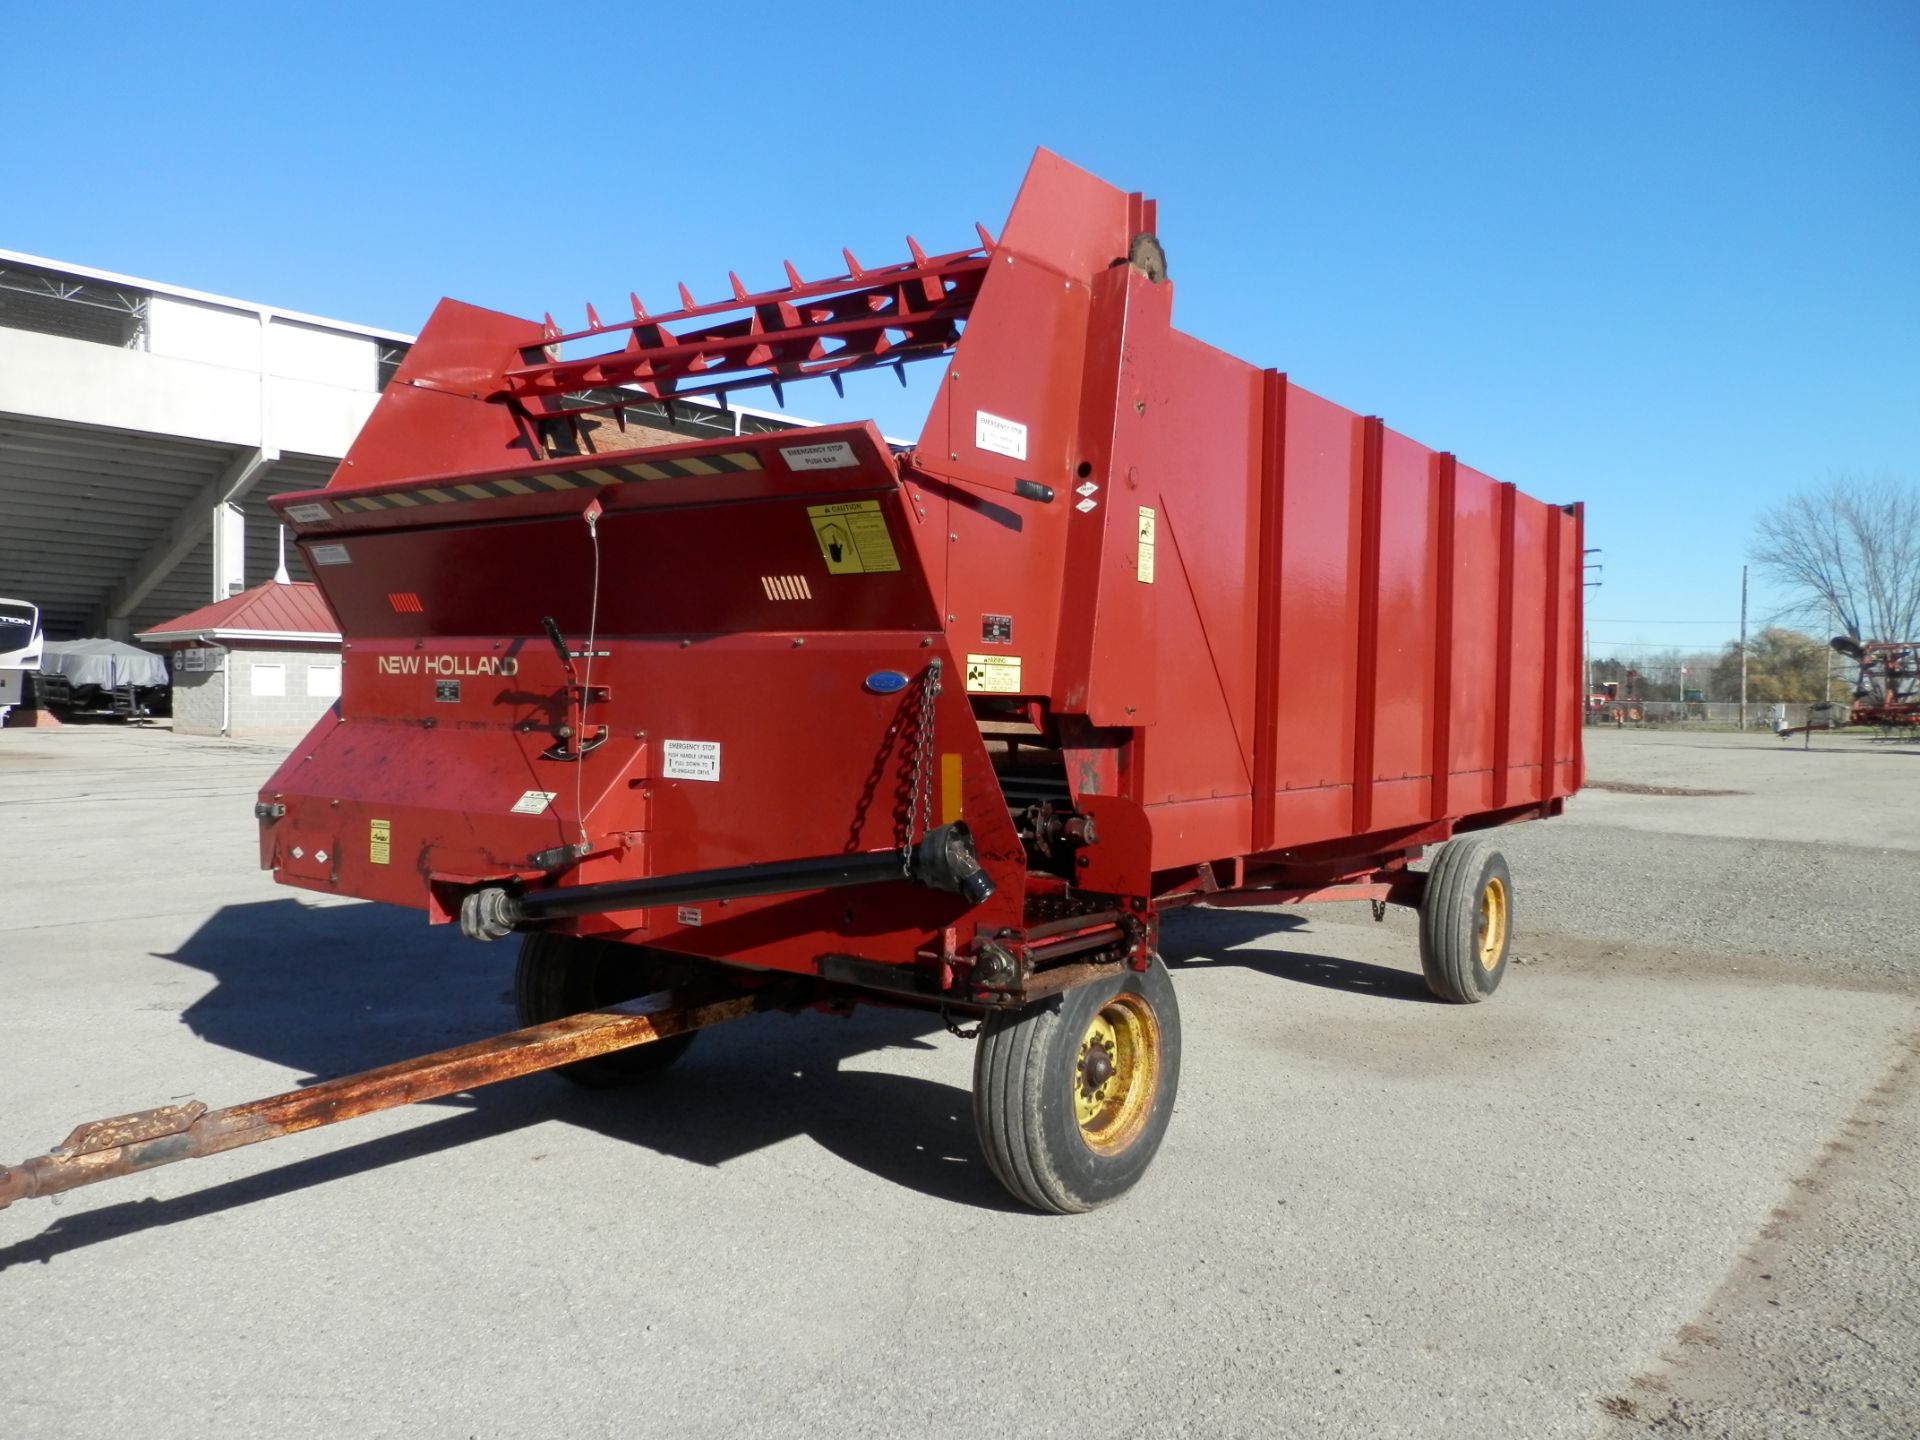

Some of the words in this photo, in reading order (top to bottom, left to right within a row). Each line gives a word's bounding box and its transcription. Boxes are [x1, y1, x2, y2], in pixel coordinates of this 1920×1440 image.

[787, 446, 826, 456] EMERGENCY
[827, 444, 844, 453] STOP
[831, 503, 862, 513] CAUTION
[378, 655, 420, 675] NEW
[425, 655, 519, 677] HOLLAND
[669, 742, 700, 751] EMERGENCY
[702, 744, 716, 752] STOP
